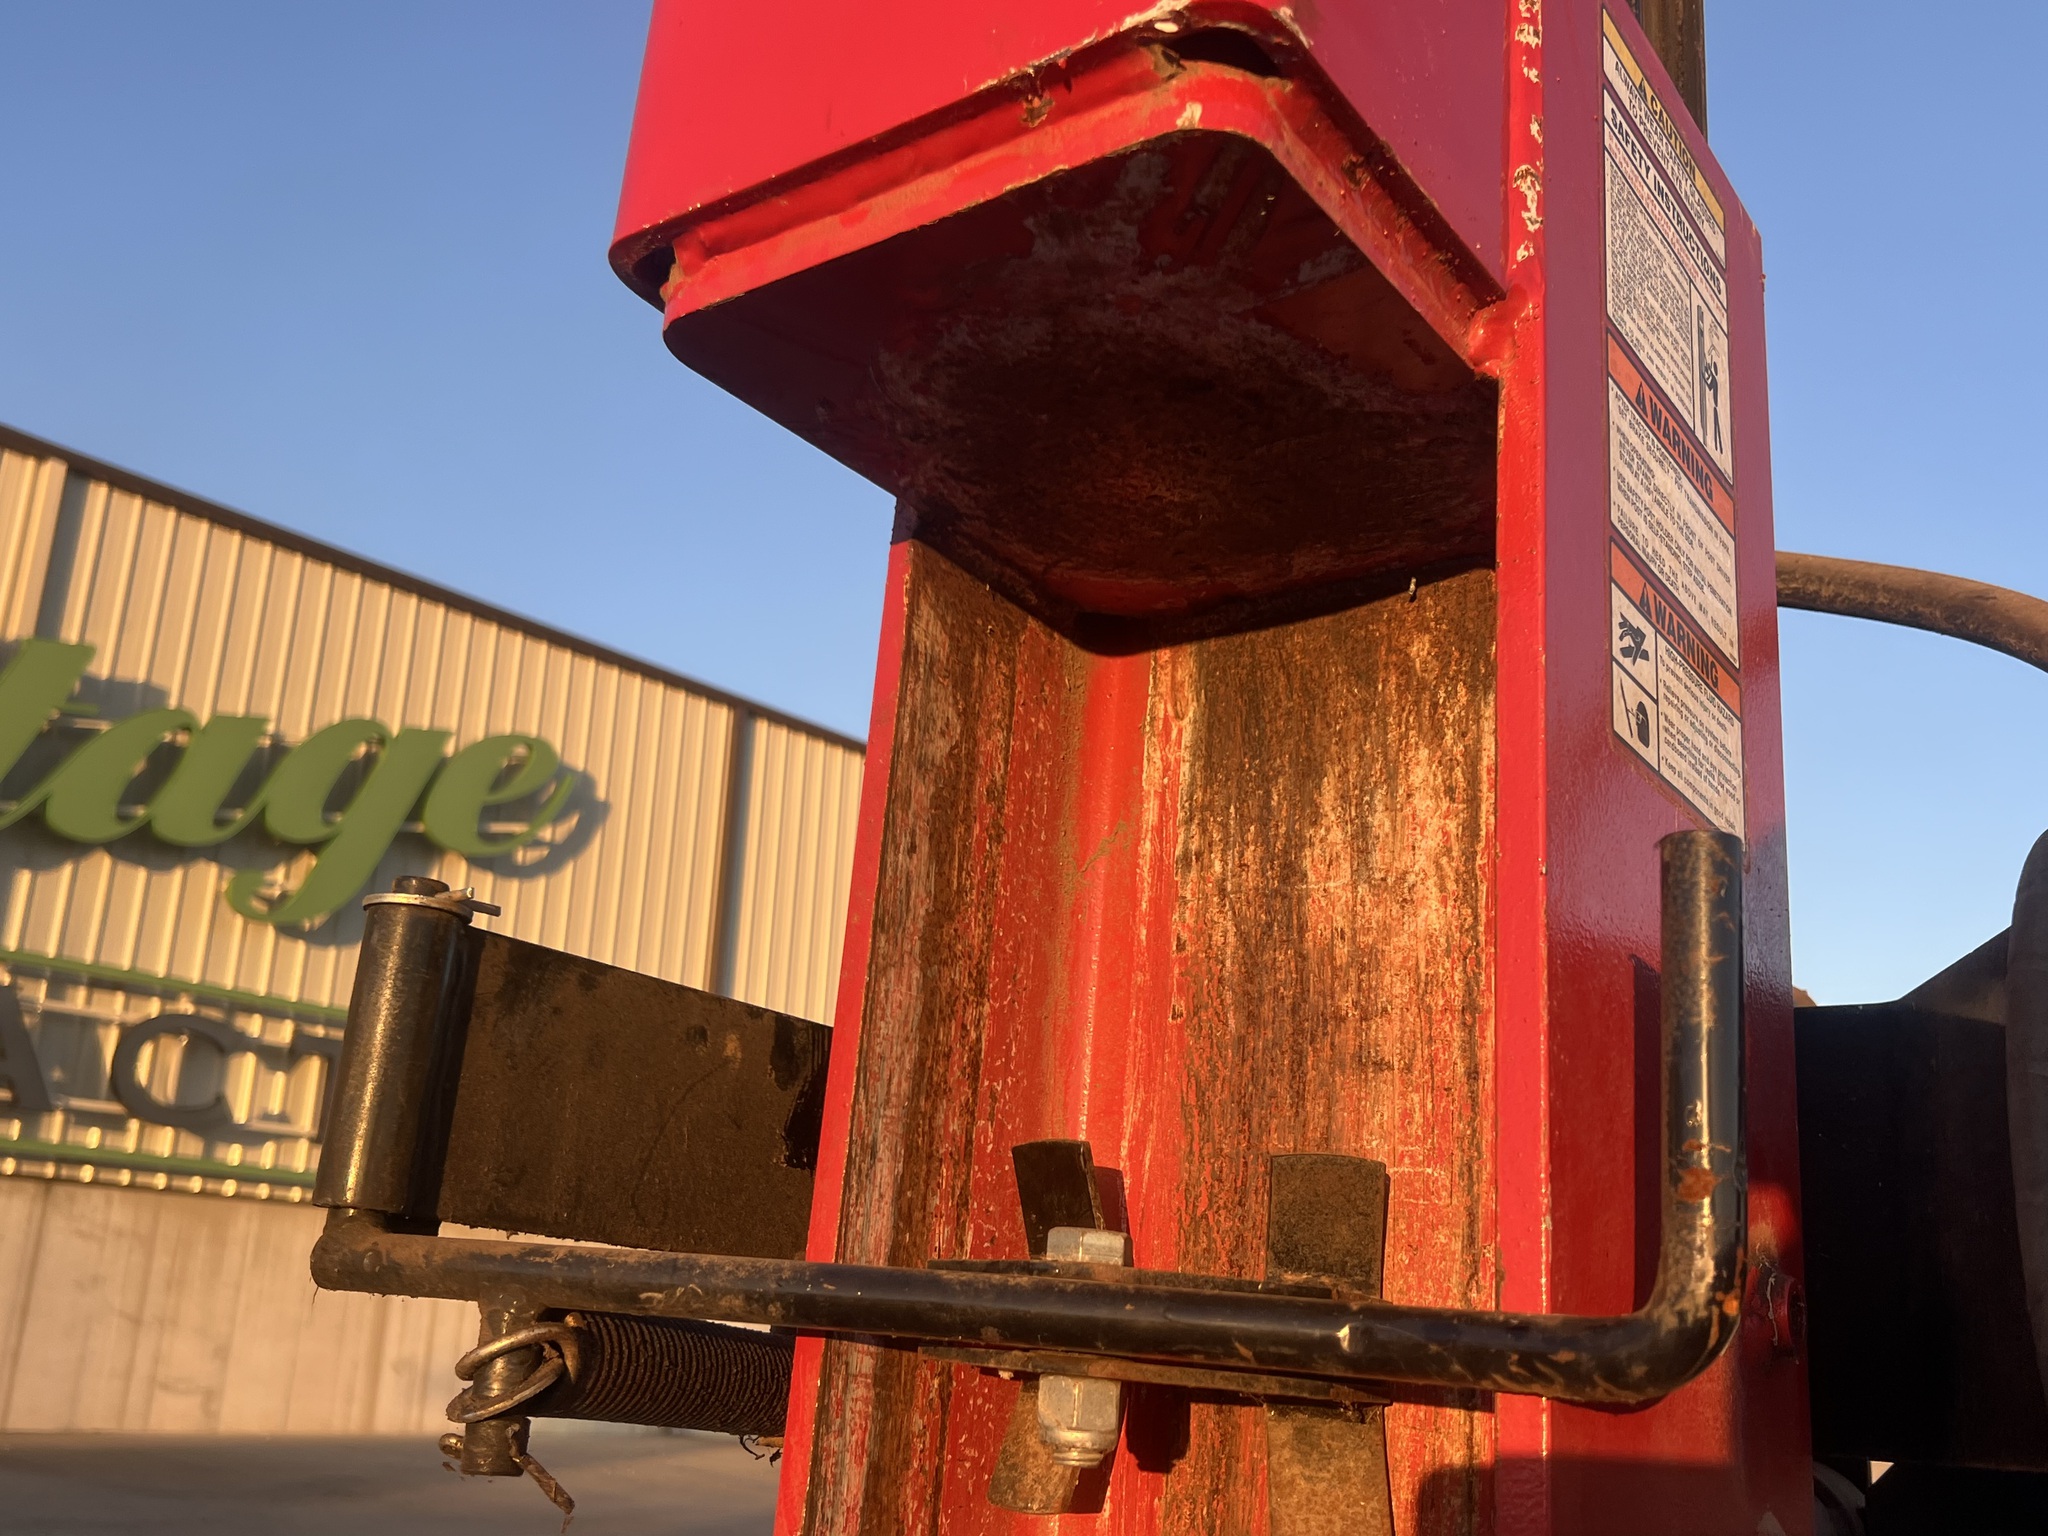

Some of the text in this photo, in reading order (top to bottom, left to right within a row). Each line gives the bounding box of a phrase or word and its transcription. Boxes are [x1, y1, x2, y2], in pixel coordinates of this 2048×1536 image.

[1614, 57, 1642, 115] ALWAYS
[1643, 104, 1663, 148] WEAR
[1664, 140, 1688, 189] SAFETY
[1628, 94, 1637, 122] TO
[1638, 112, 1669, 173] PREVENT
[1670, 164, 1682, 195] EYE
[1650, 90, 1696, 183] CAUTION
[1610, 104, 1650, 184] SAFETY
[1653, 172, 1721, 297] INSTRUCTIONS
[1648, 393, 1714, 505] WARNING
[1653, 593, 1718, 692] WARNING
